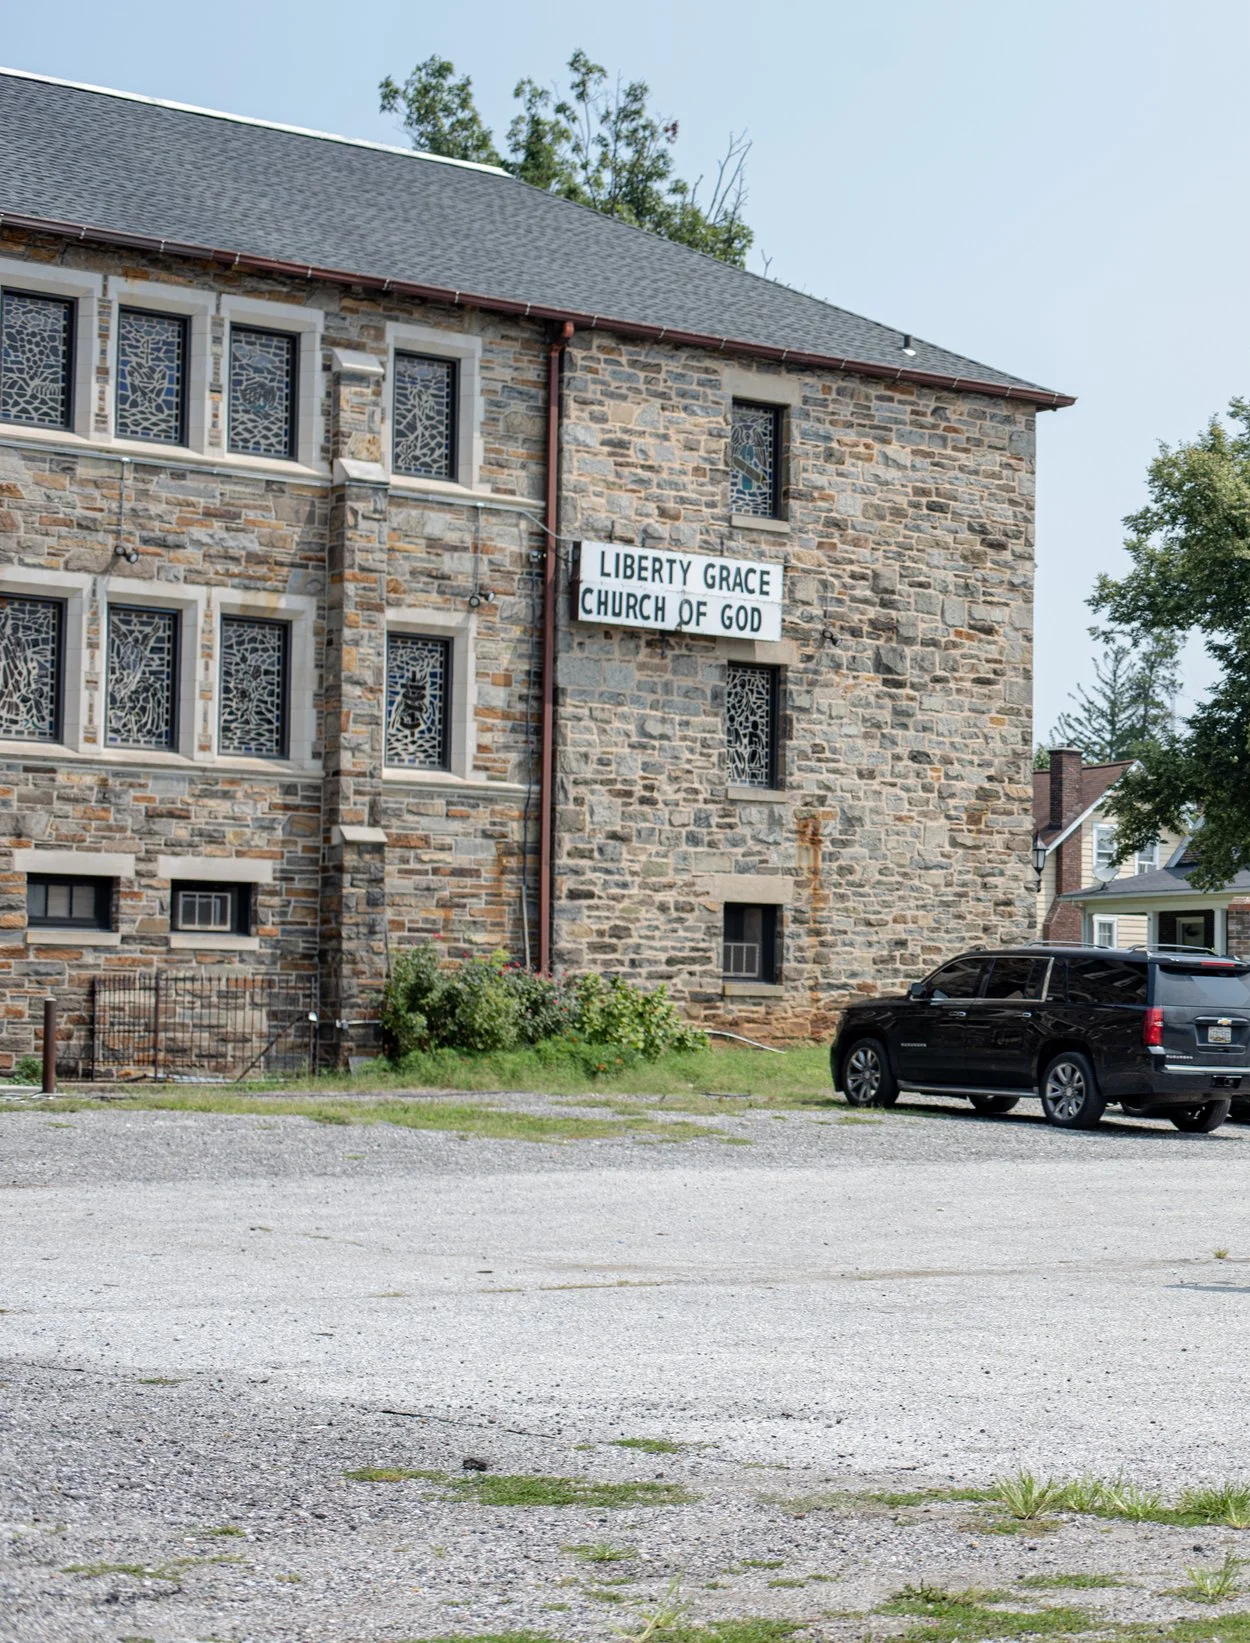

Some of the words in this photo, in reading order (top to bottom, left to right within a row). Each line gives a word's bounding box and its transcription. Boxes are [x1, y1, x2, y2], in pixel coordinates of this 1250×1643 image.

[600, 550, 692, 586] LIBERTY
[703, 563, 771, 596] GRACE
[580, 587, 666, 623] CHURCH
[679, 599, 708, 627] OF
[721, 604, 763, 633] GOD
